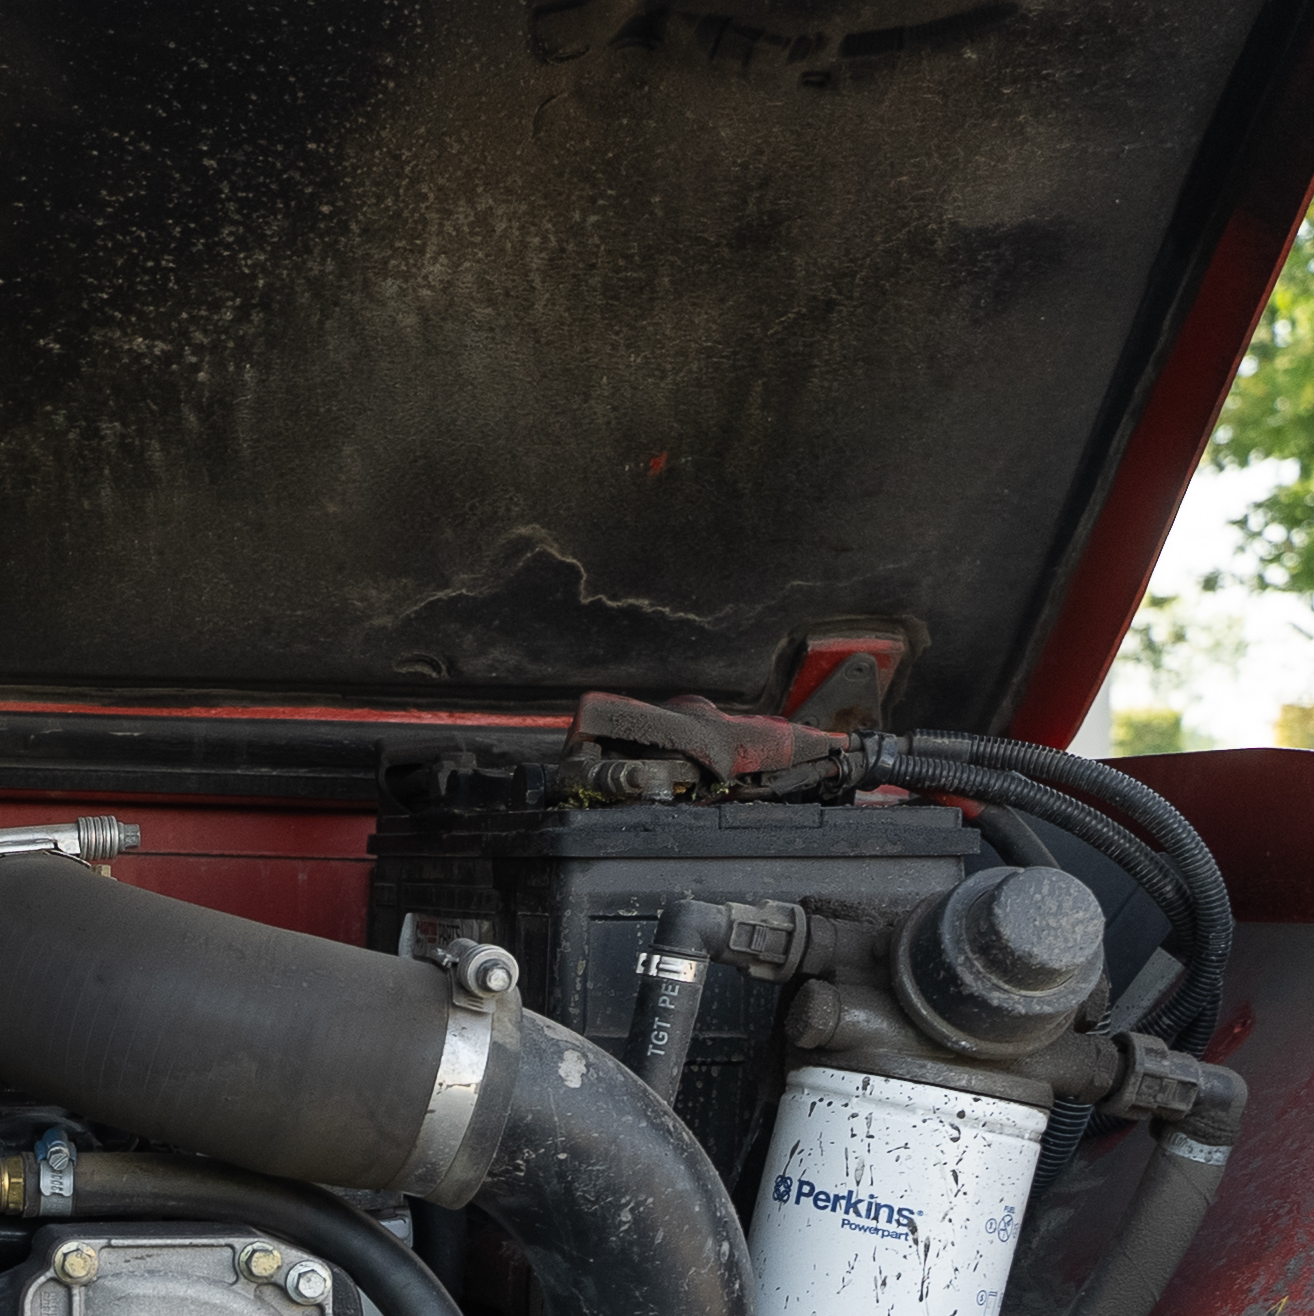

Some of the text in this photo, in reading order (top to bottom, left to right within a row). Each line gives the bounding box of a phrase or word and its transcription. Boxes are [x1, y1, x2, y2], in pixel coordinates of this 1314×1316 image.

[647, 978, 680, 1057] TGT PE
[794, 1179, 916, 1228] Perkins
[840, 1217, 910, 1243] Powerpart
